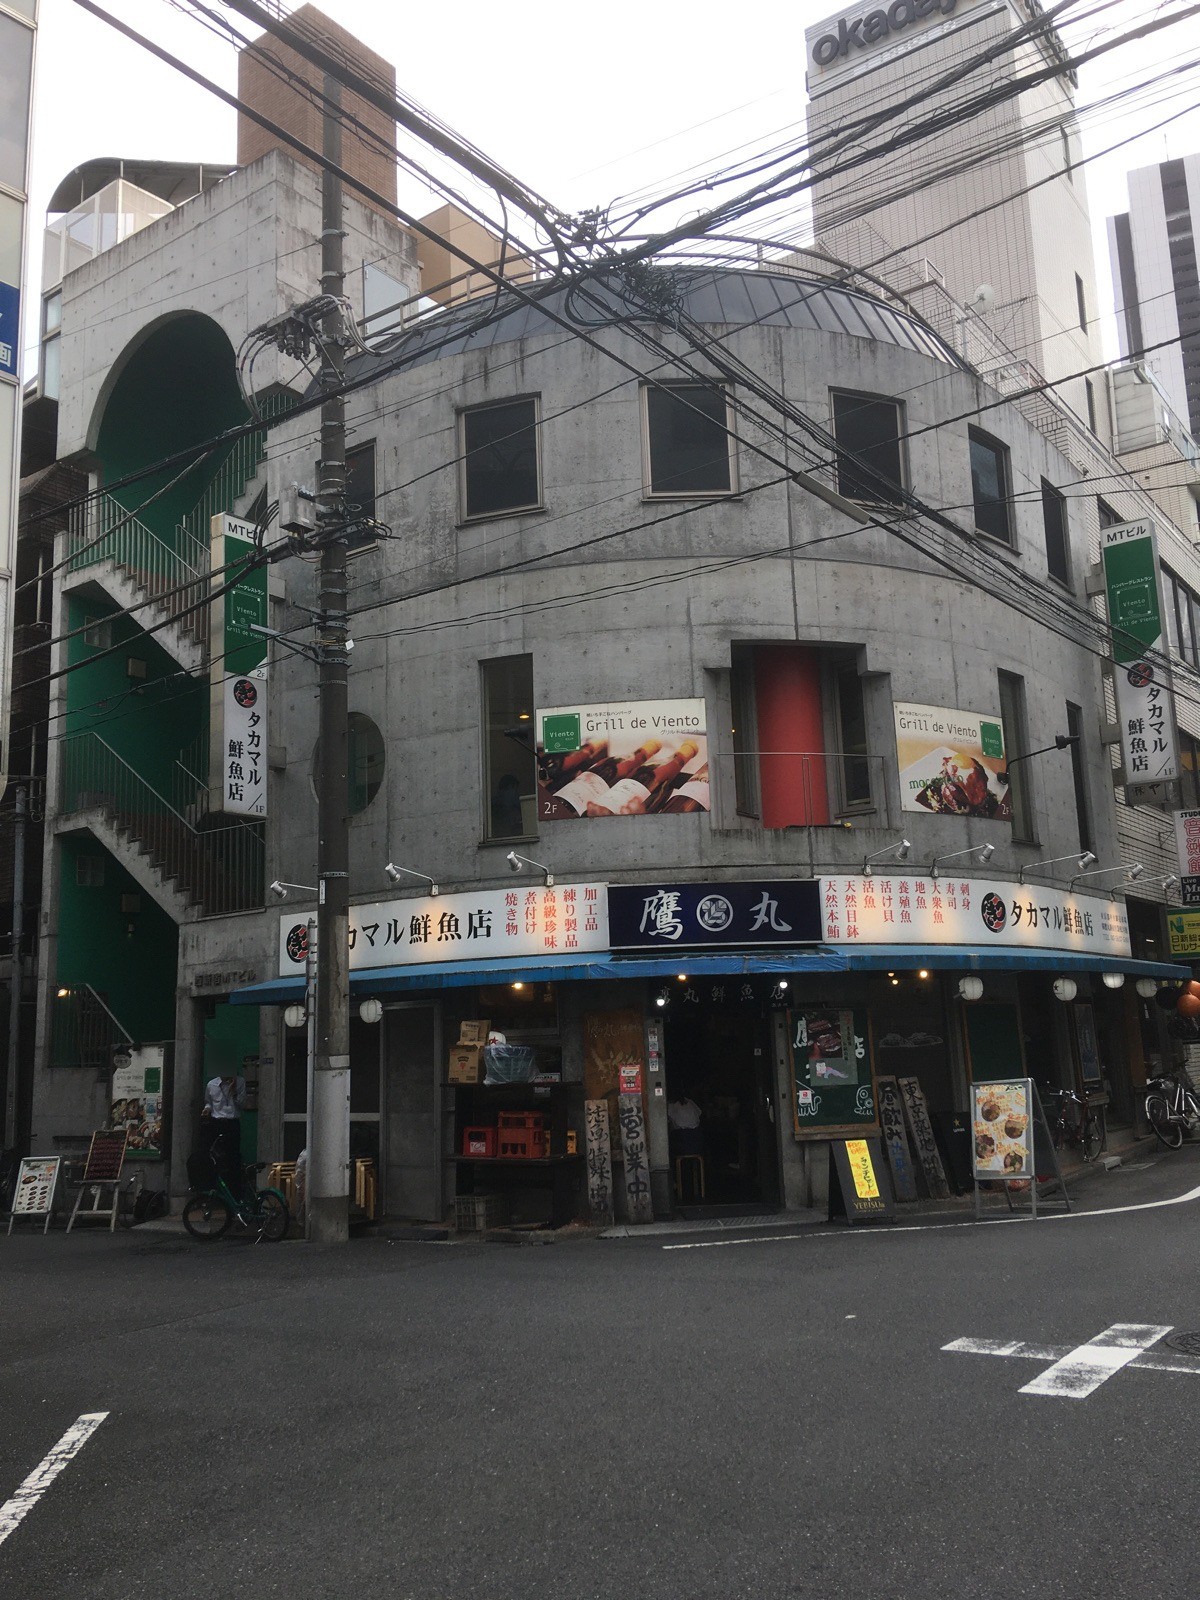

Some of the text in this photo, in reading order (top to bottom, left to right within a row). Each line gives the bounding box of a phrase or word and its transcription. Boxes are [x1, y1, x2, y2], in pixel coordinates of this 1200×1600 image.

[1106, 525, 1147, 543] MTビル
[586, 715, 700, 732] Grill de Viento
[899, 717, 977, 739] Grill de Viento
[1147, 687, 1169, 754] タカマル
[247, 711, 262, 786] タカマル
[1128, 717, 1149, 772] 鮮魚店
[228, 739, 244, 801] 鮮魚店
[544, 801, 558, 815] 2F
[505, 892, 518, 936] 焼き物
[524, 891, 538, 935] 煮付け
[583, 887, 598, 931] 加工品
[638, 889, 793, 941] 鷹 丸
[825, 880, 840, 939] 天然本鮪
[844, 880, 860, 939] 天然目鉢
[862, 880, 877, 909] 活魚
[880, 880, 895, 923] 活け貝
[897, 881, 913, 924] 養殖魚
[914, 881, 928, 909] 地魚
[930, 881, 944, 925] 大衆魚
[946, 882, 958, 910] 寿司
[959, 883, 971, 911] 刺身
[543, 889, 558, 949] 高級珍味
[563, 888, 578, 948] 練り製品
[1010, 900, 1094, 937] タカマル鮮魚店
[1171, 933, 1200, 943] 日新総
[620, 1106, 648, 1202] 営業中
